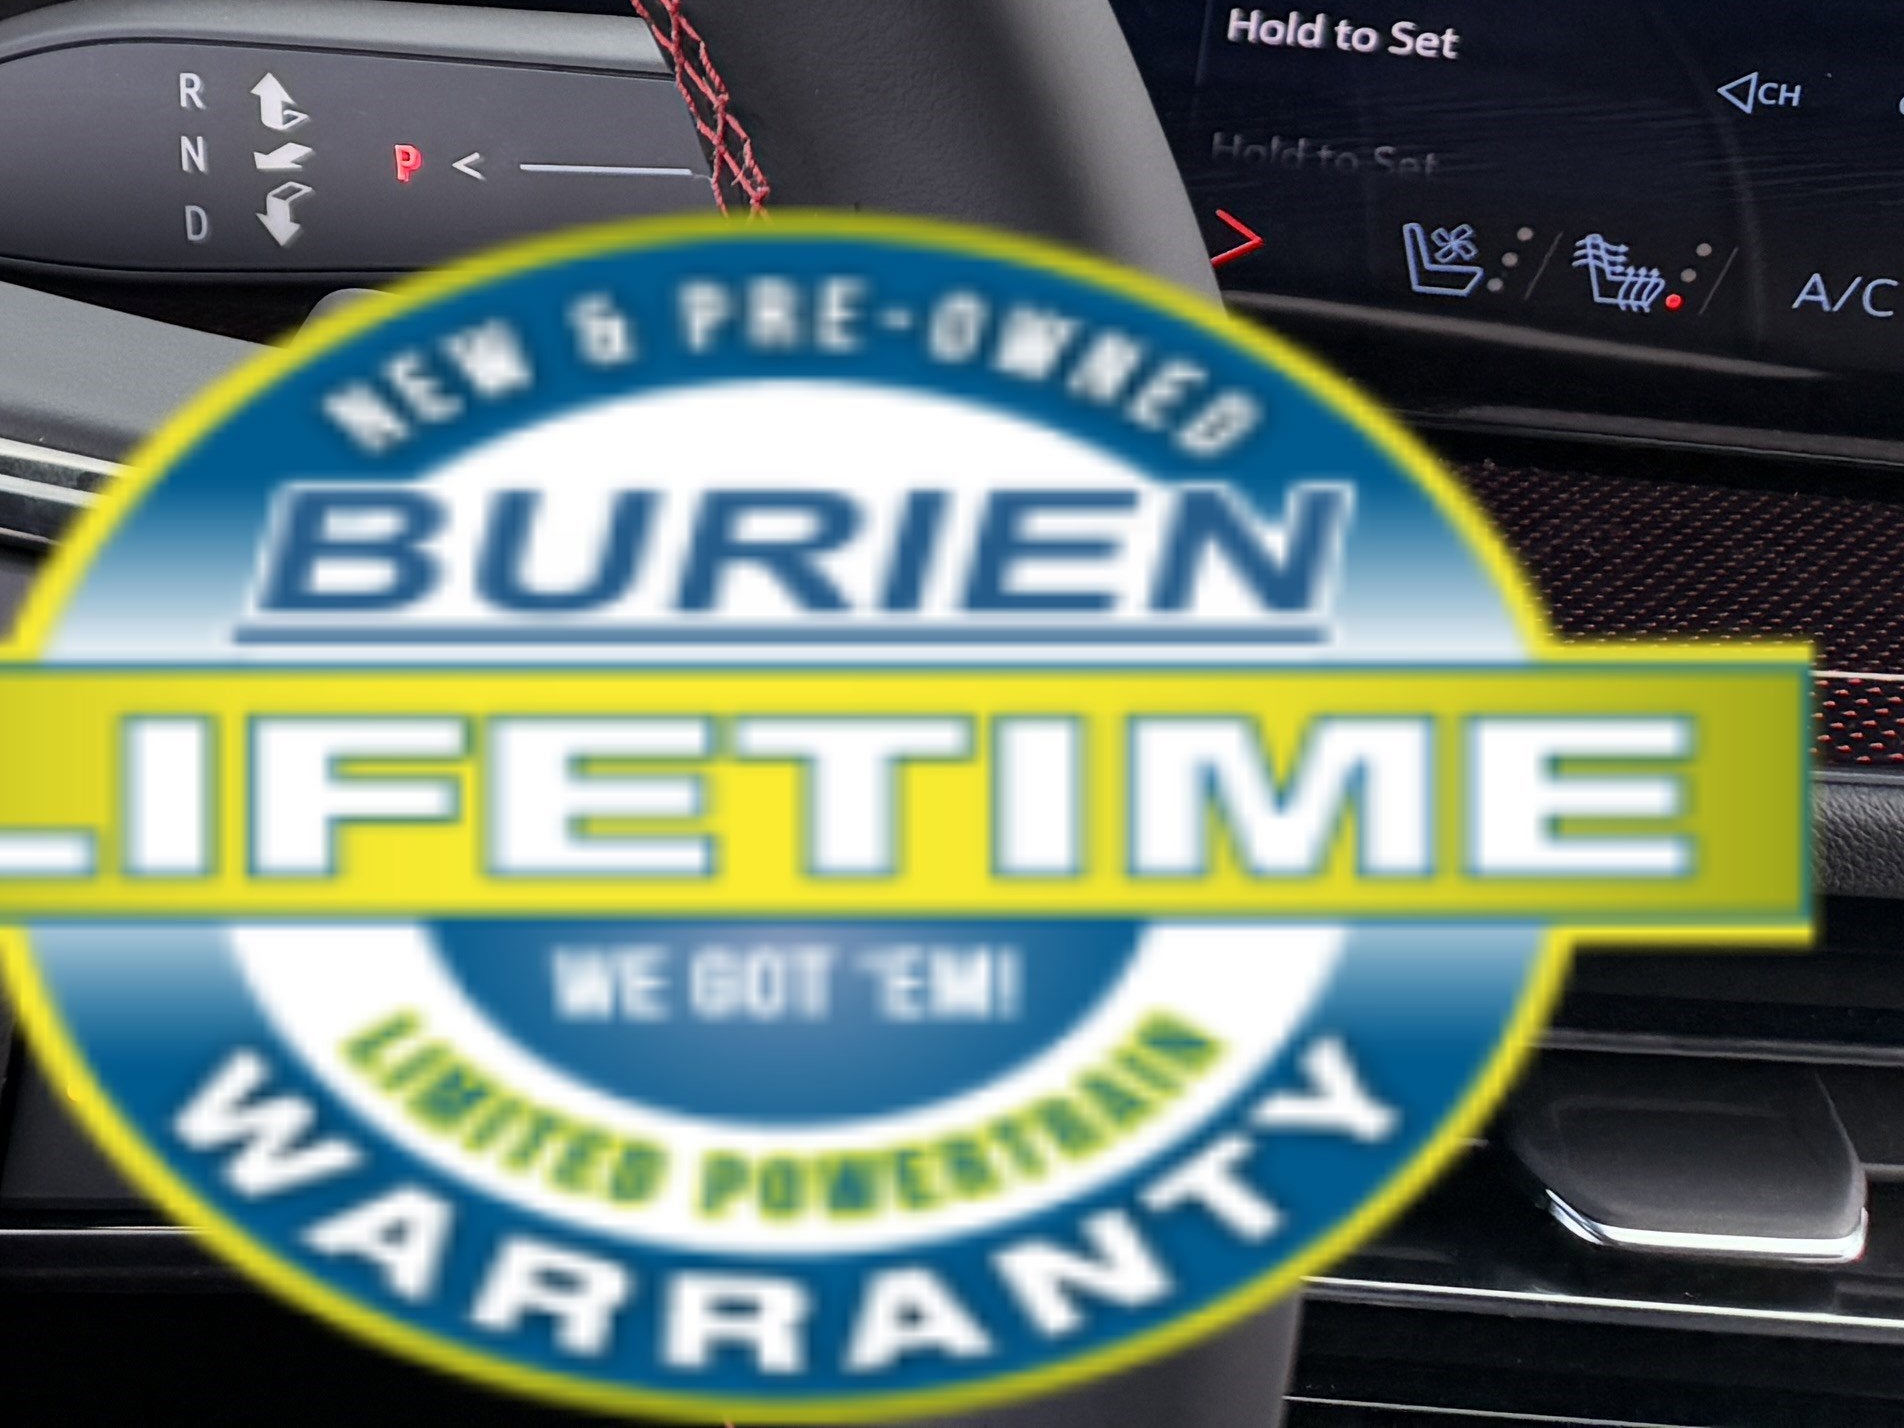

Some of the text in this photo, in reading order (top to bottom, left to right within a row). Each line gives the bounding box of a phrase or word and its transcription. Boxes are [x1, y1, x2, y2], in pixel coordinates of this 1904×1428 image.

[1227, 7, 1460, 60] Hold to Set
[179, 72, 206, 110] R
[1758, 82, 1802, 107] CH
[180, 135, 209, 174] N
[393, 143, 424, 184] P
[184, 205, 211, 242] D
[1792, 272, 1900, 318] A/C
